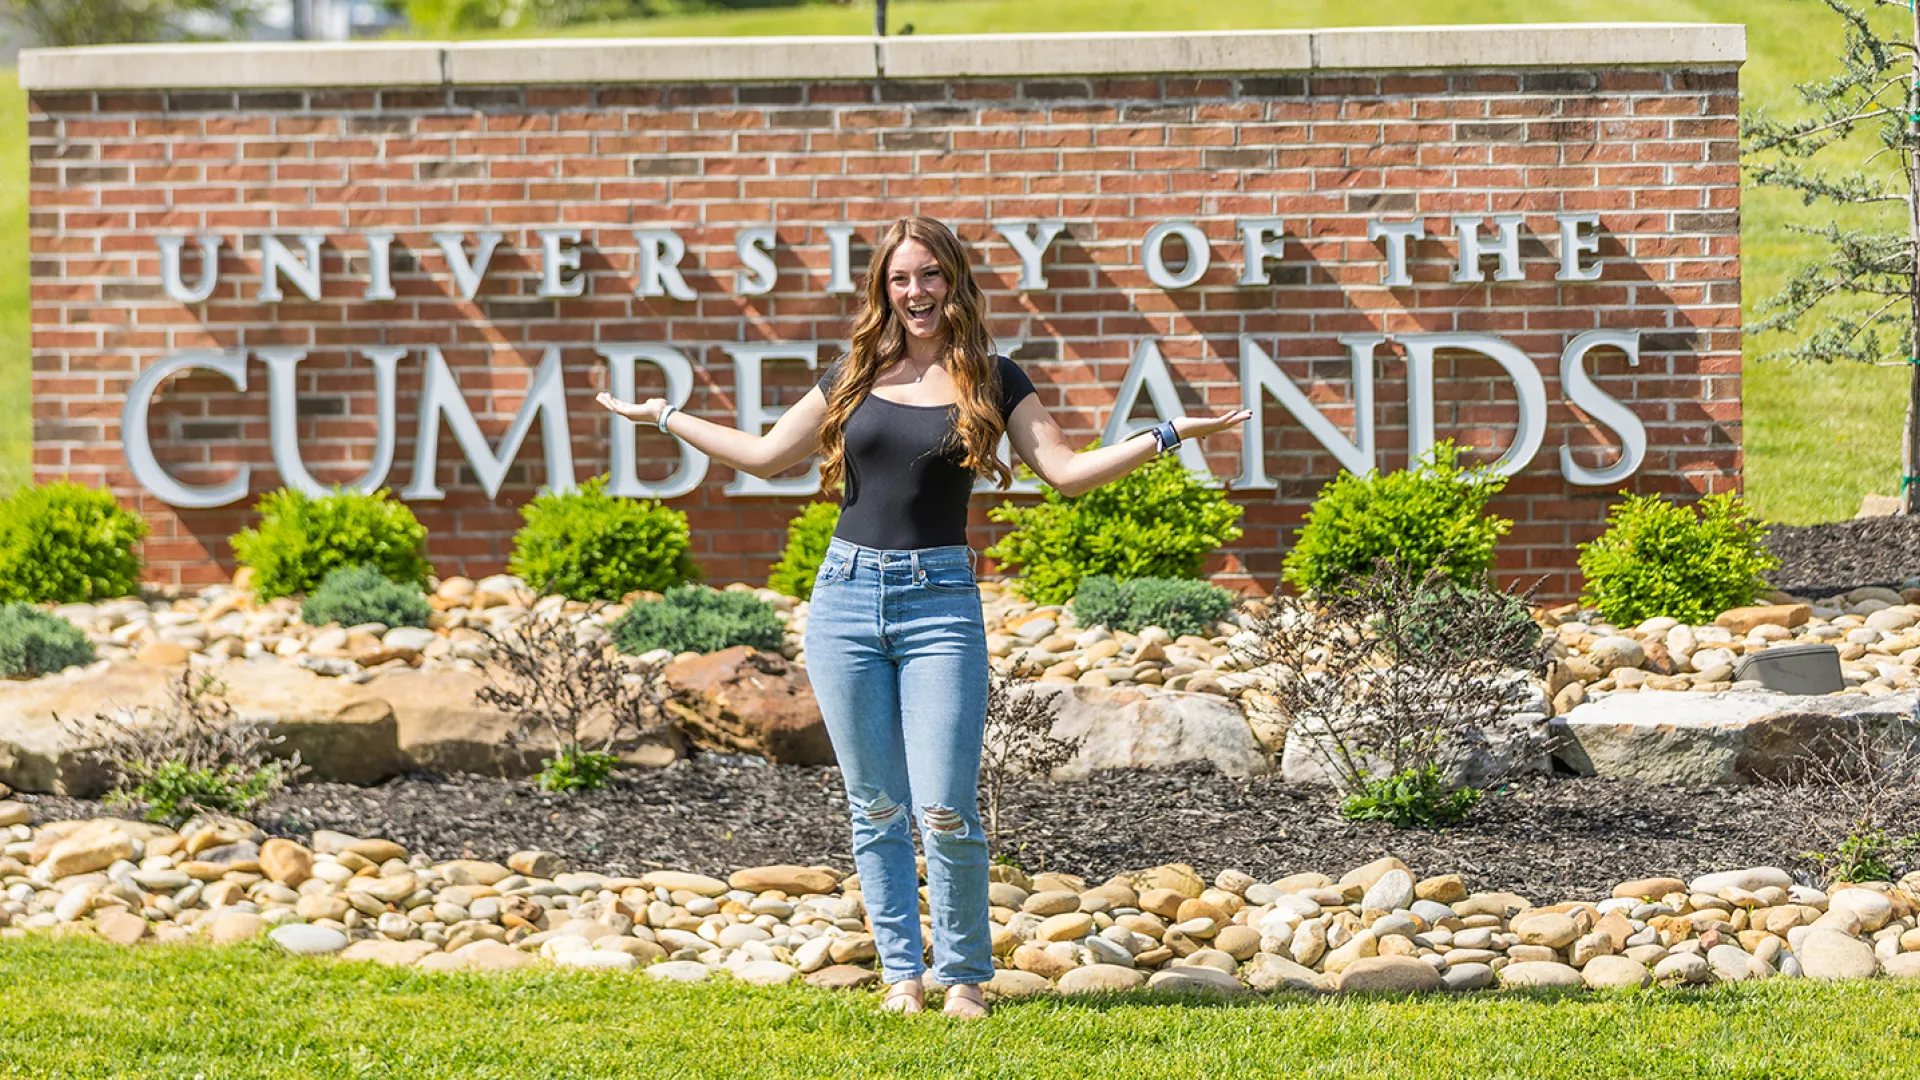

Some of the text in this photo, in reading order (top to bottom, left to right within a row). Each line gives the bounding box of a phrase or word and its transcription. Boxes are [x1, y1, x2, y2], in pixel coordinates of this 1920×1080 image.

[156, 213, 1603, 302] UNIVERSIY OF THE
[120, 328, 1648, 508] CUMBEANDS
